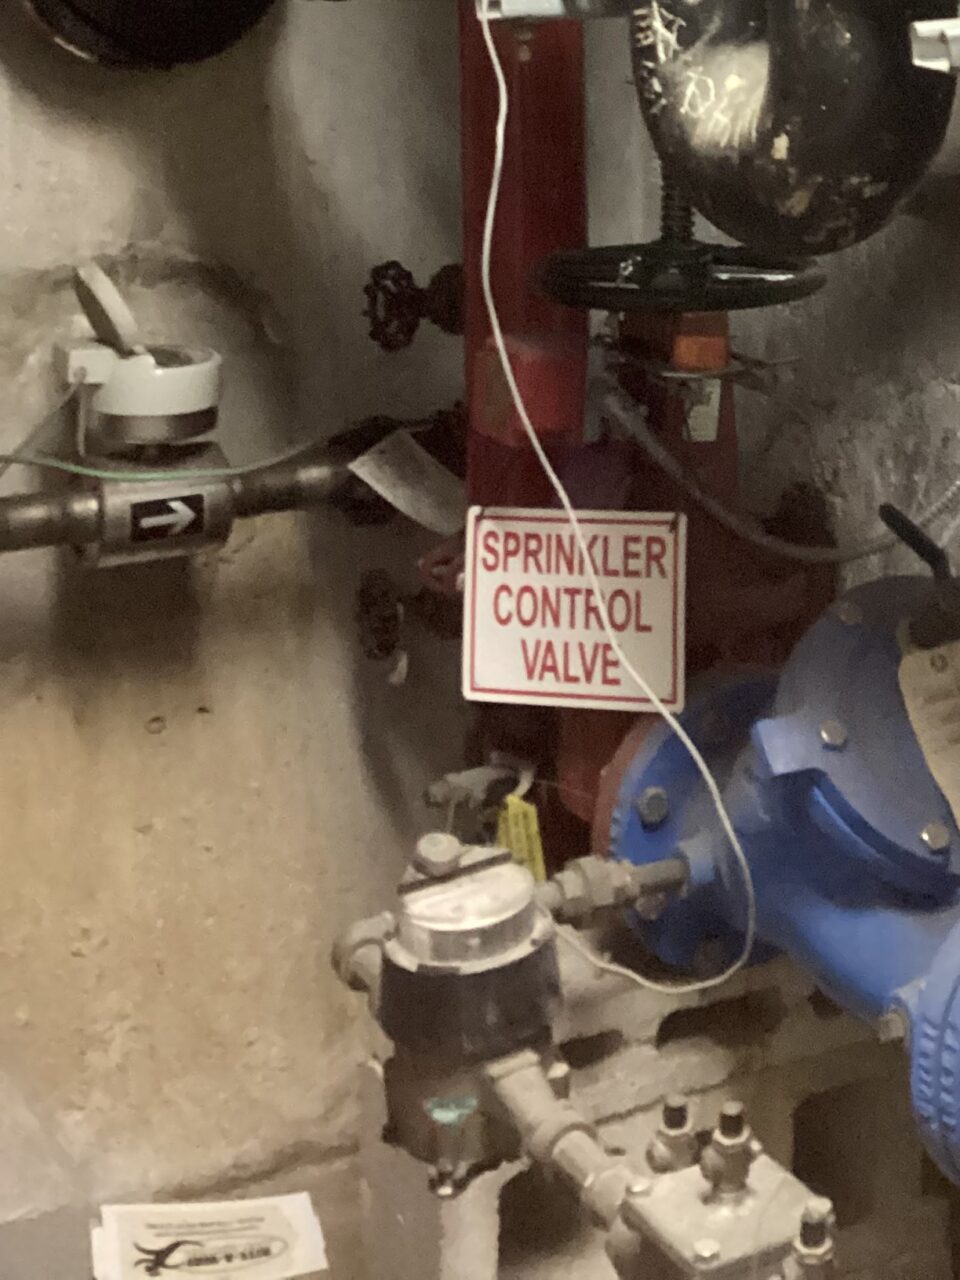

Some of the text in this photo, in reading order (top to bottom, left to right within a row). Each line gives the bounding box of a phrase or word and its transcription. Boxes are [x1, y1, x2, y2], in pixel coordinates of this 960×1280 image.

[482, 530, 667, 578] SPRINKLER
[493, 584, 652, 632] CONTROL
[521, 639, 621, 686] VALVE
